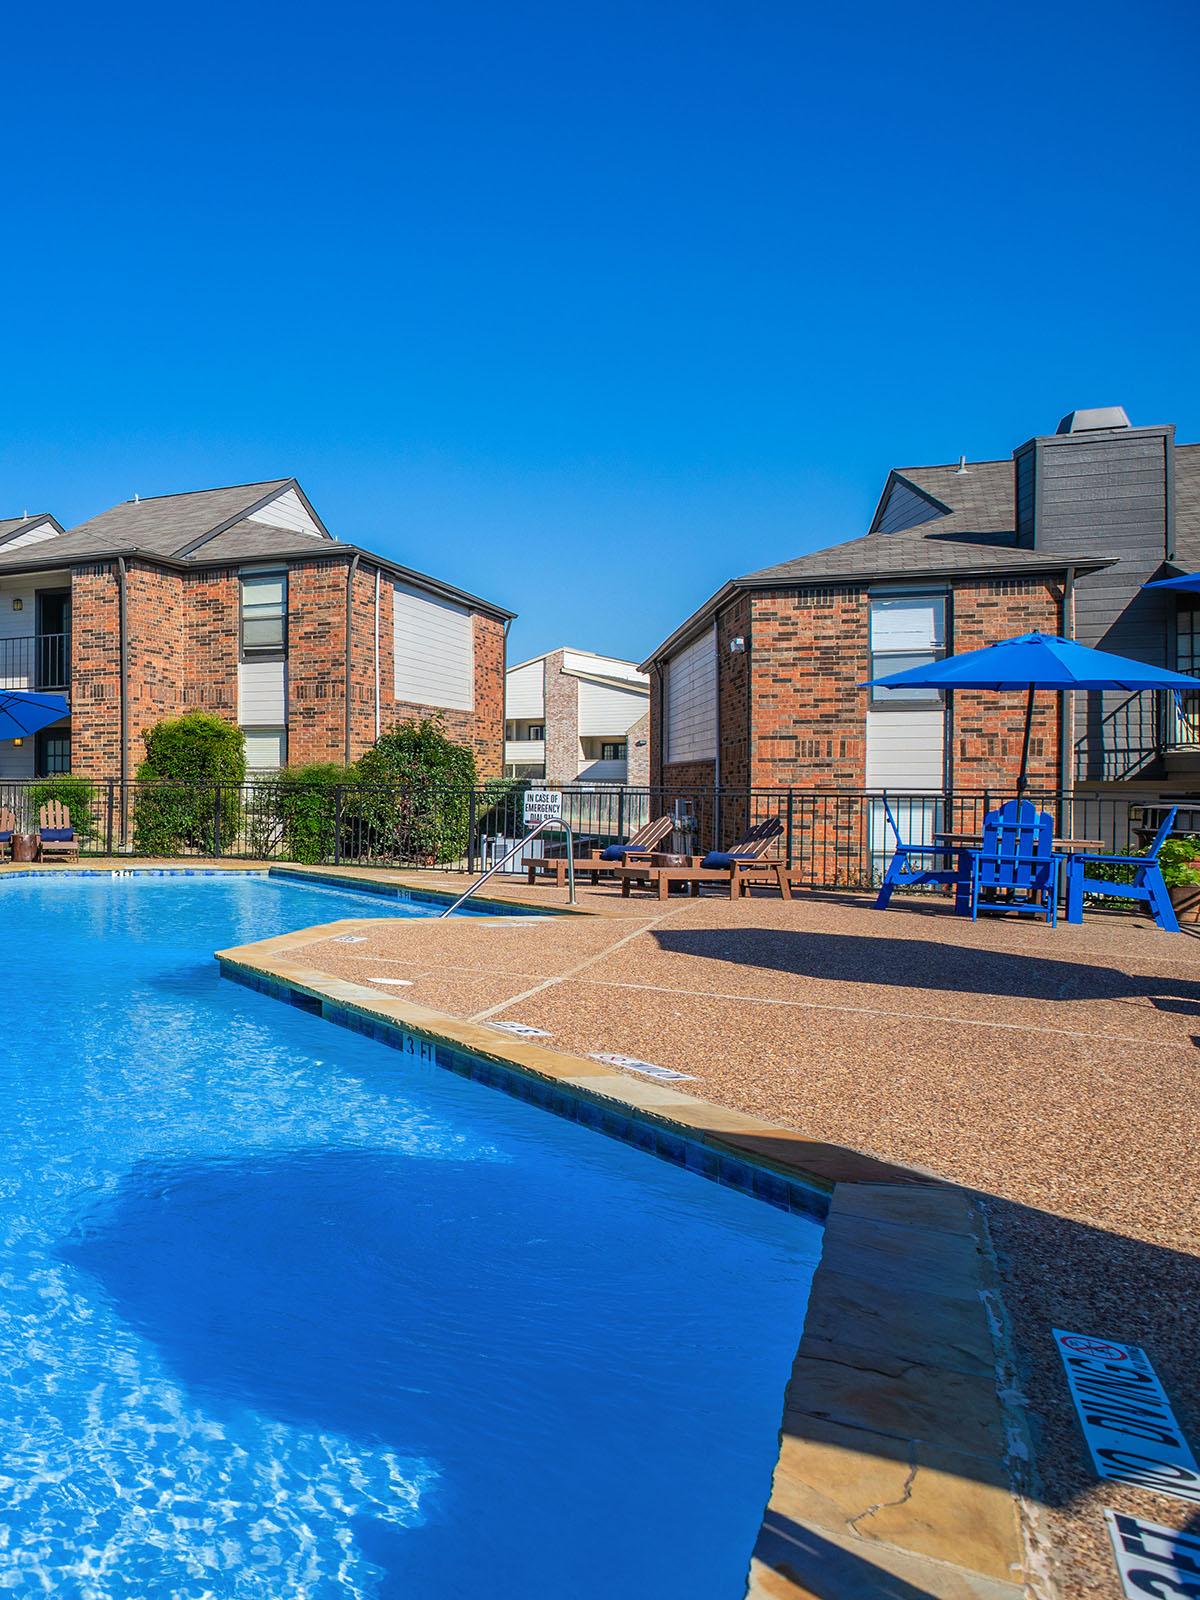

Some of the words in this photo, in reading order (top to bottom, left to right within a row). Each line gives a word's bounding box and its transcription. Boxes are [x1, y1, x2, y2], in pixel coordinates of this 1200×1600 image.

[525, 803, 560, 813] EMERGENCY
[527, 793, 534, 802] IN
[535, 793, 549, 803] CASE
[550, 794, 558, 803] OF
[530, 813, 542, 821] DIAL
[407, 1036, 414, 1054] 3
[420, 1040, 433, 1061] FT
[1067, 1358, 1181, 1448] DIVING
[1096, 1448, 1200, 1501] NO
[1113, 1513, 1200, 1574] FT
